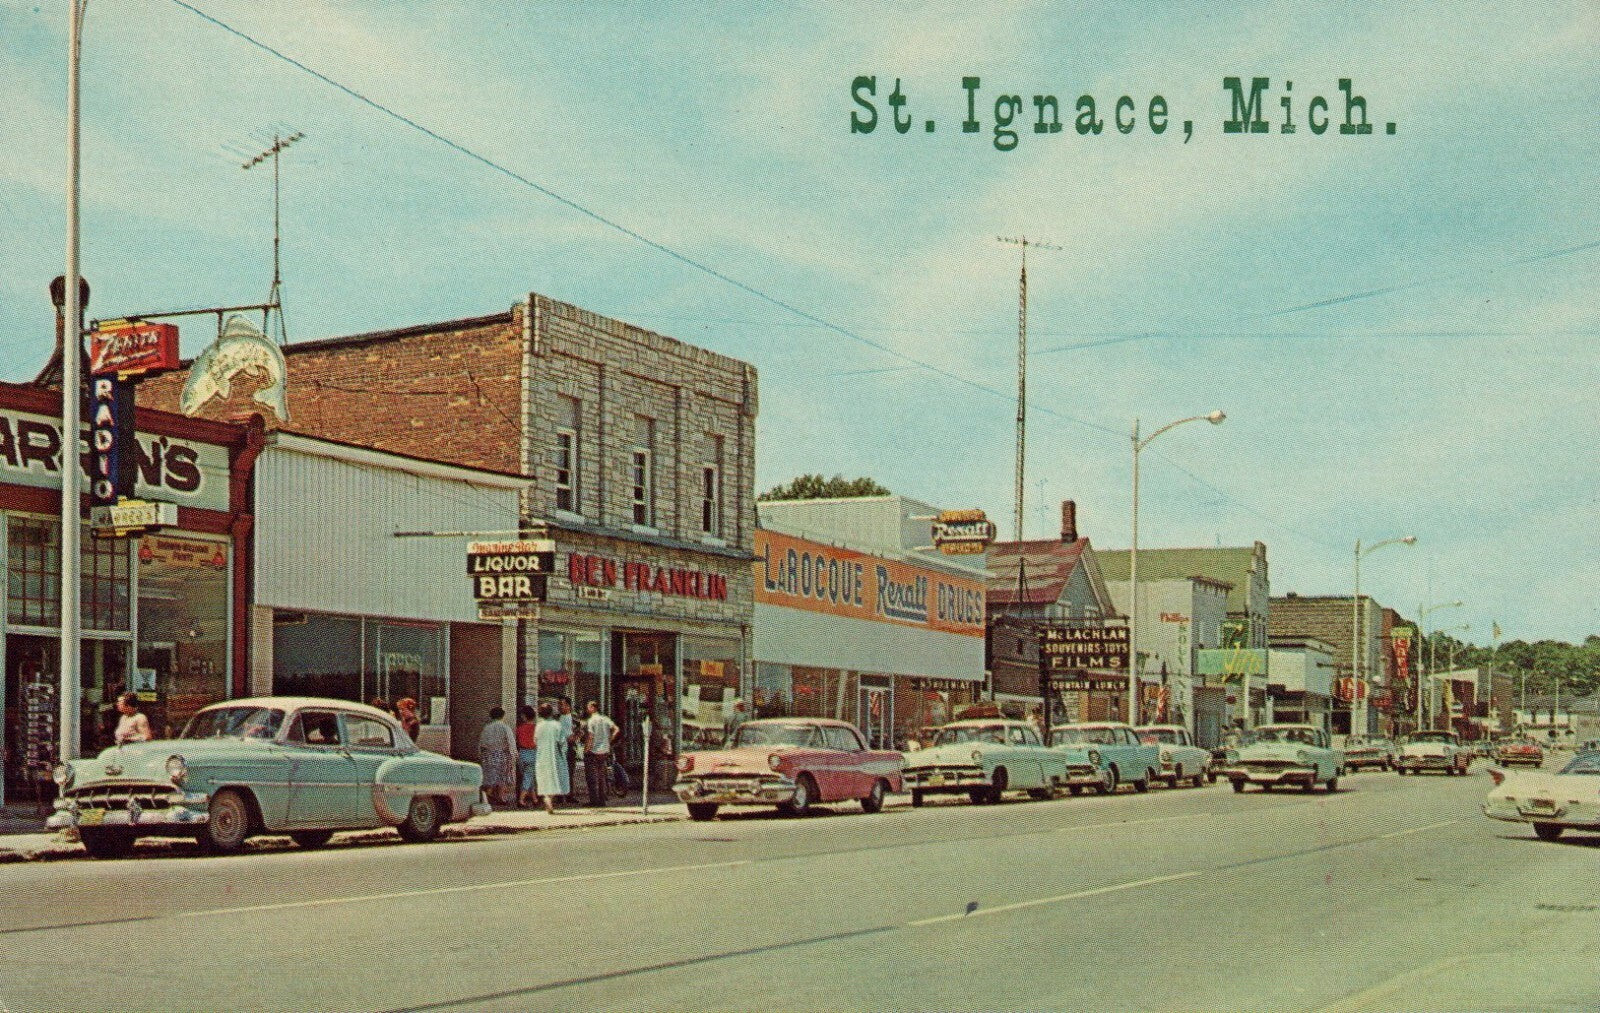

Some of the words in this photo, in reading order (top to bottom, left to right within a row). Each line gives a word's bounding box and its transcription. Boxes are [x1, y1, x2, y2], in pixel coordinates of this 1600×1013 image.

[95, 379, 115, 499] RADIO
[474, 556, 541, 573] LIQUOR
[569, 552, 617, 587] BEN
[624, 562, 728, 601] FRANKLIN
[480, 576, 532, 598] BAR
[875, 566, 928, 622] Rexall
[937, 582, 983, 626] DRUGS
[1052, 656, 1121, 668] FILMS
